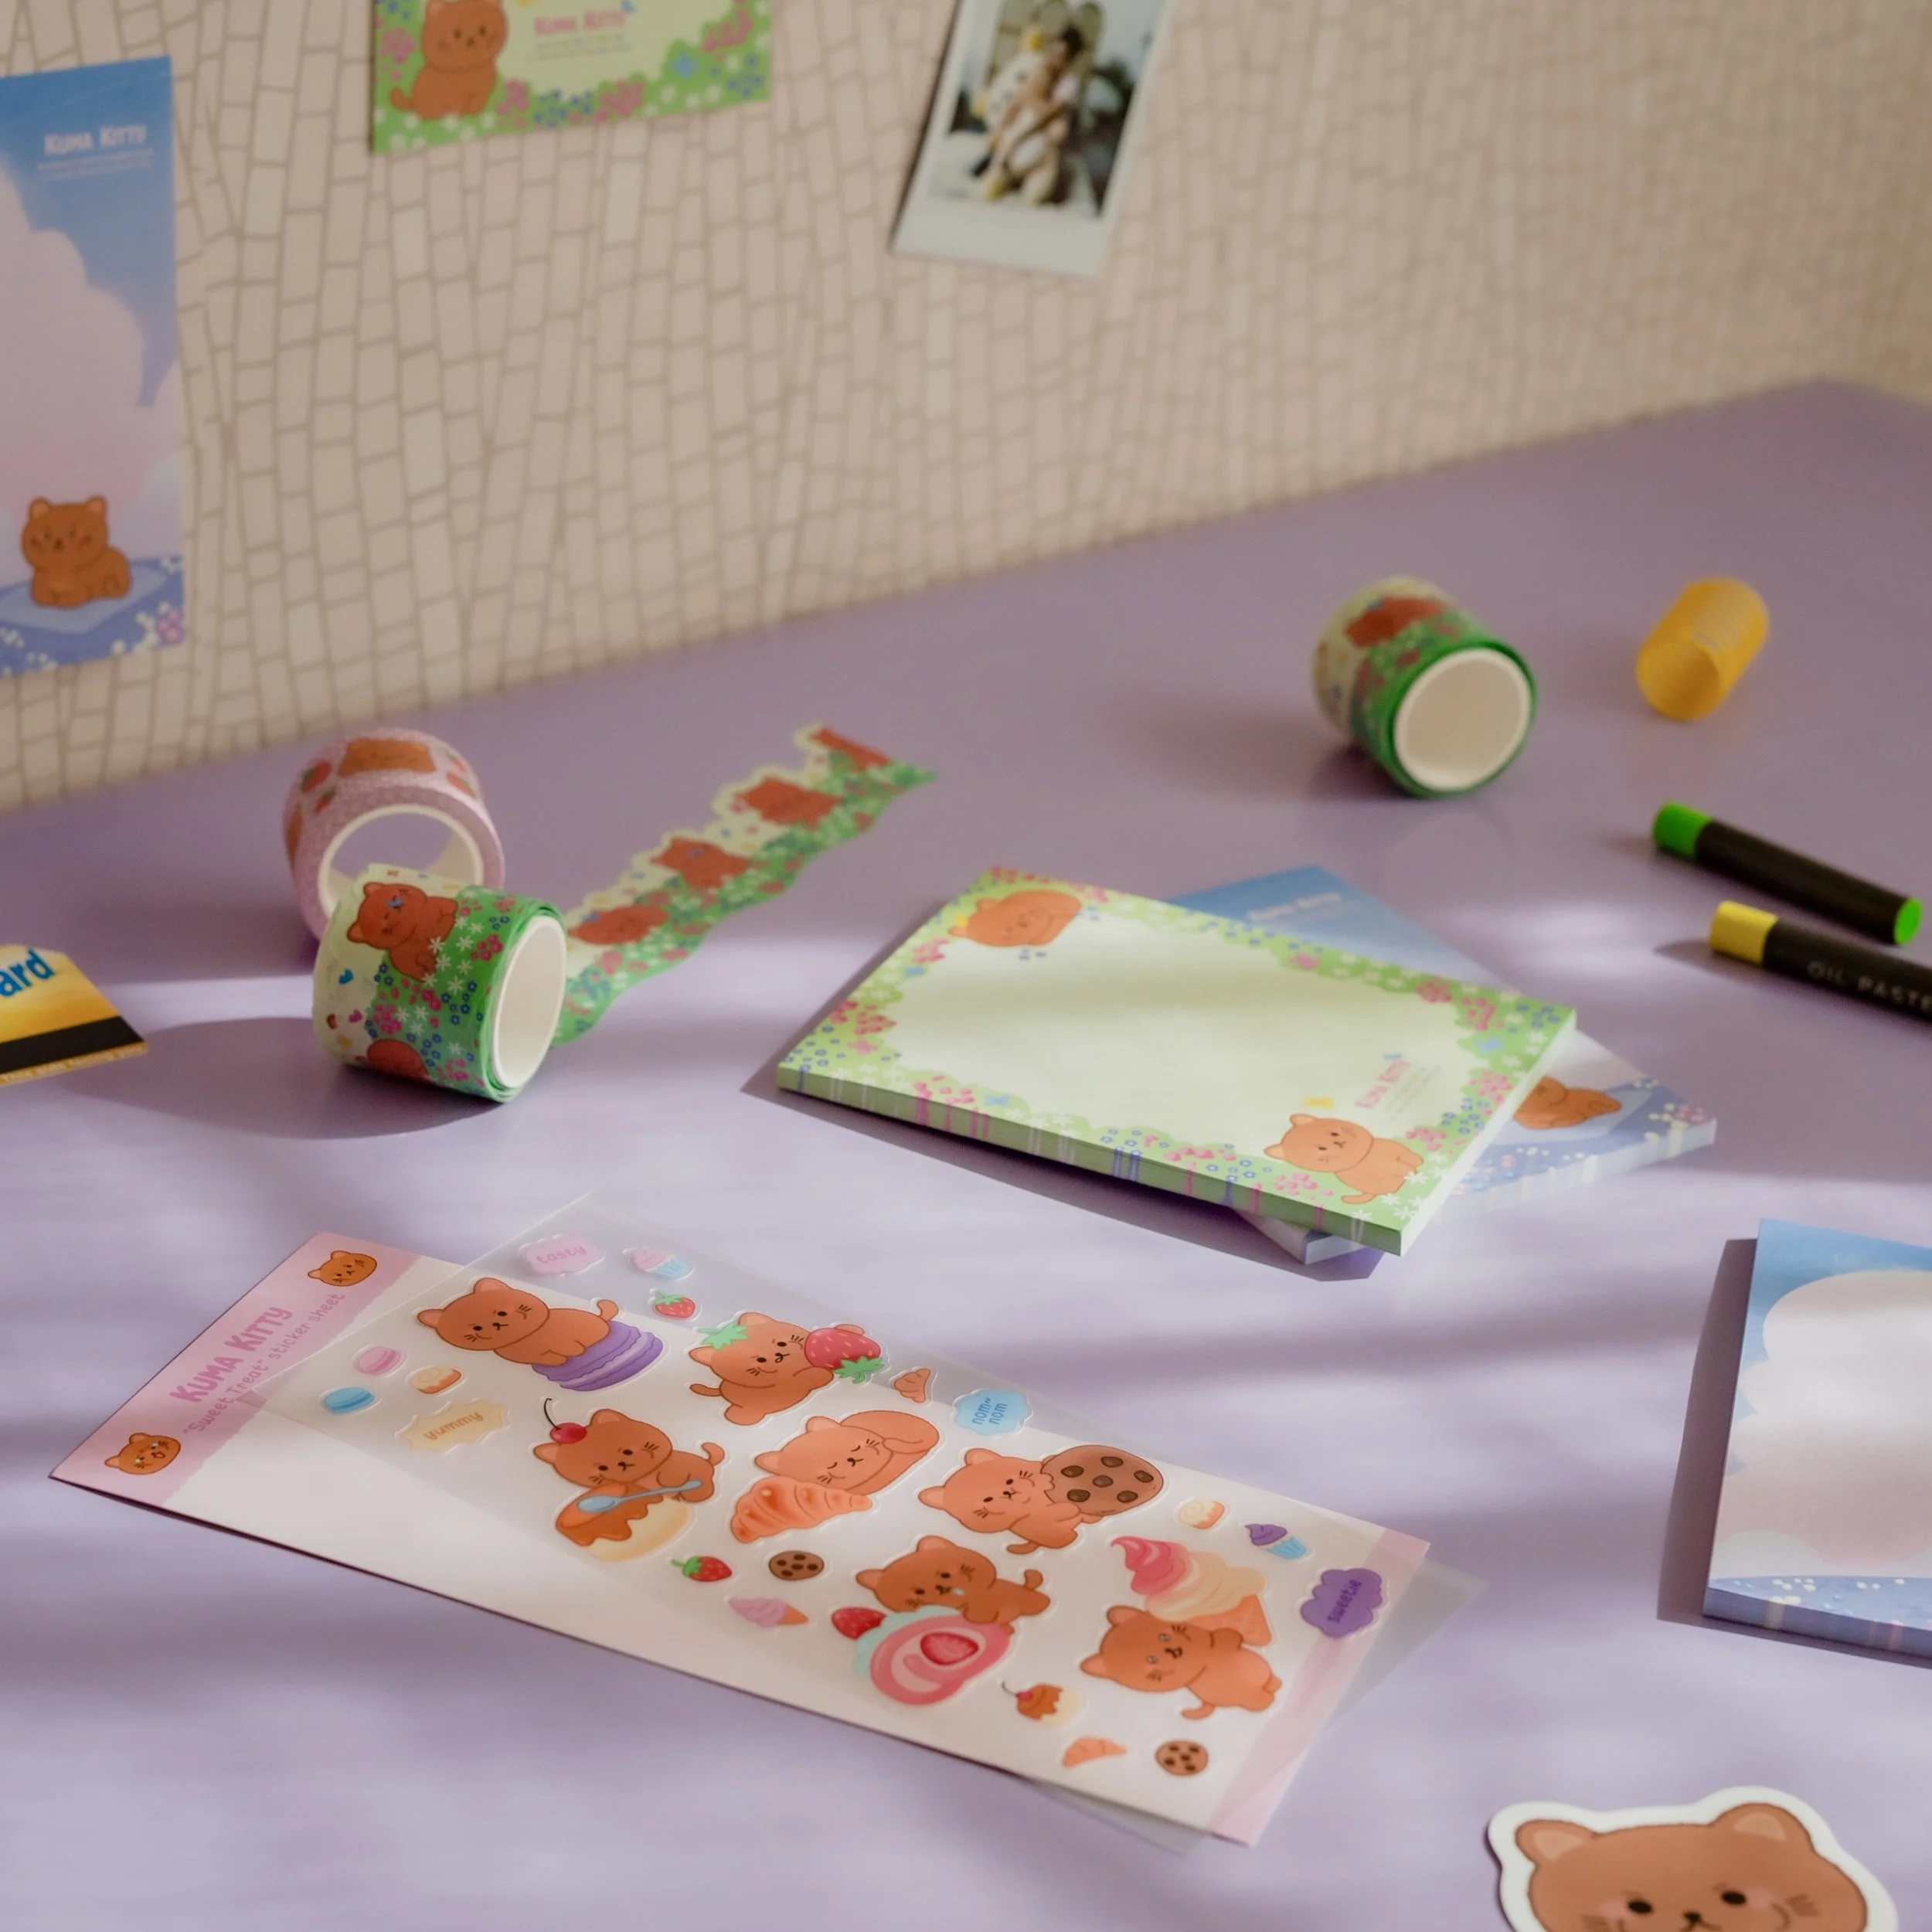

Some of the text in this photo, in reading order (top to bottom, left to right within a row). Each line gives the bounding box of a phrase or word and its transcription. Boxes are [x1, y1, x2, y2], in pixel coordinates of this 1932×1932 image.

[536, 1245, 588, 1264] tasty
[268, 1321, 311, 1359] sticker
[308, 1293, 345, 1322] sheet
[169, 1306, 293, 1403] KUMA KITTY
[423, 1412, 484, 1440] yummy
[988, 1403, 1008, 1425] nom
[1327, 1579, 1362, 1624] sweetie
